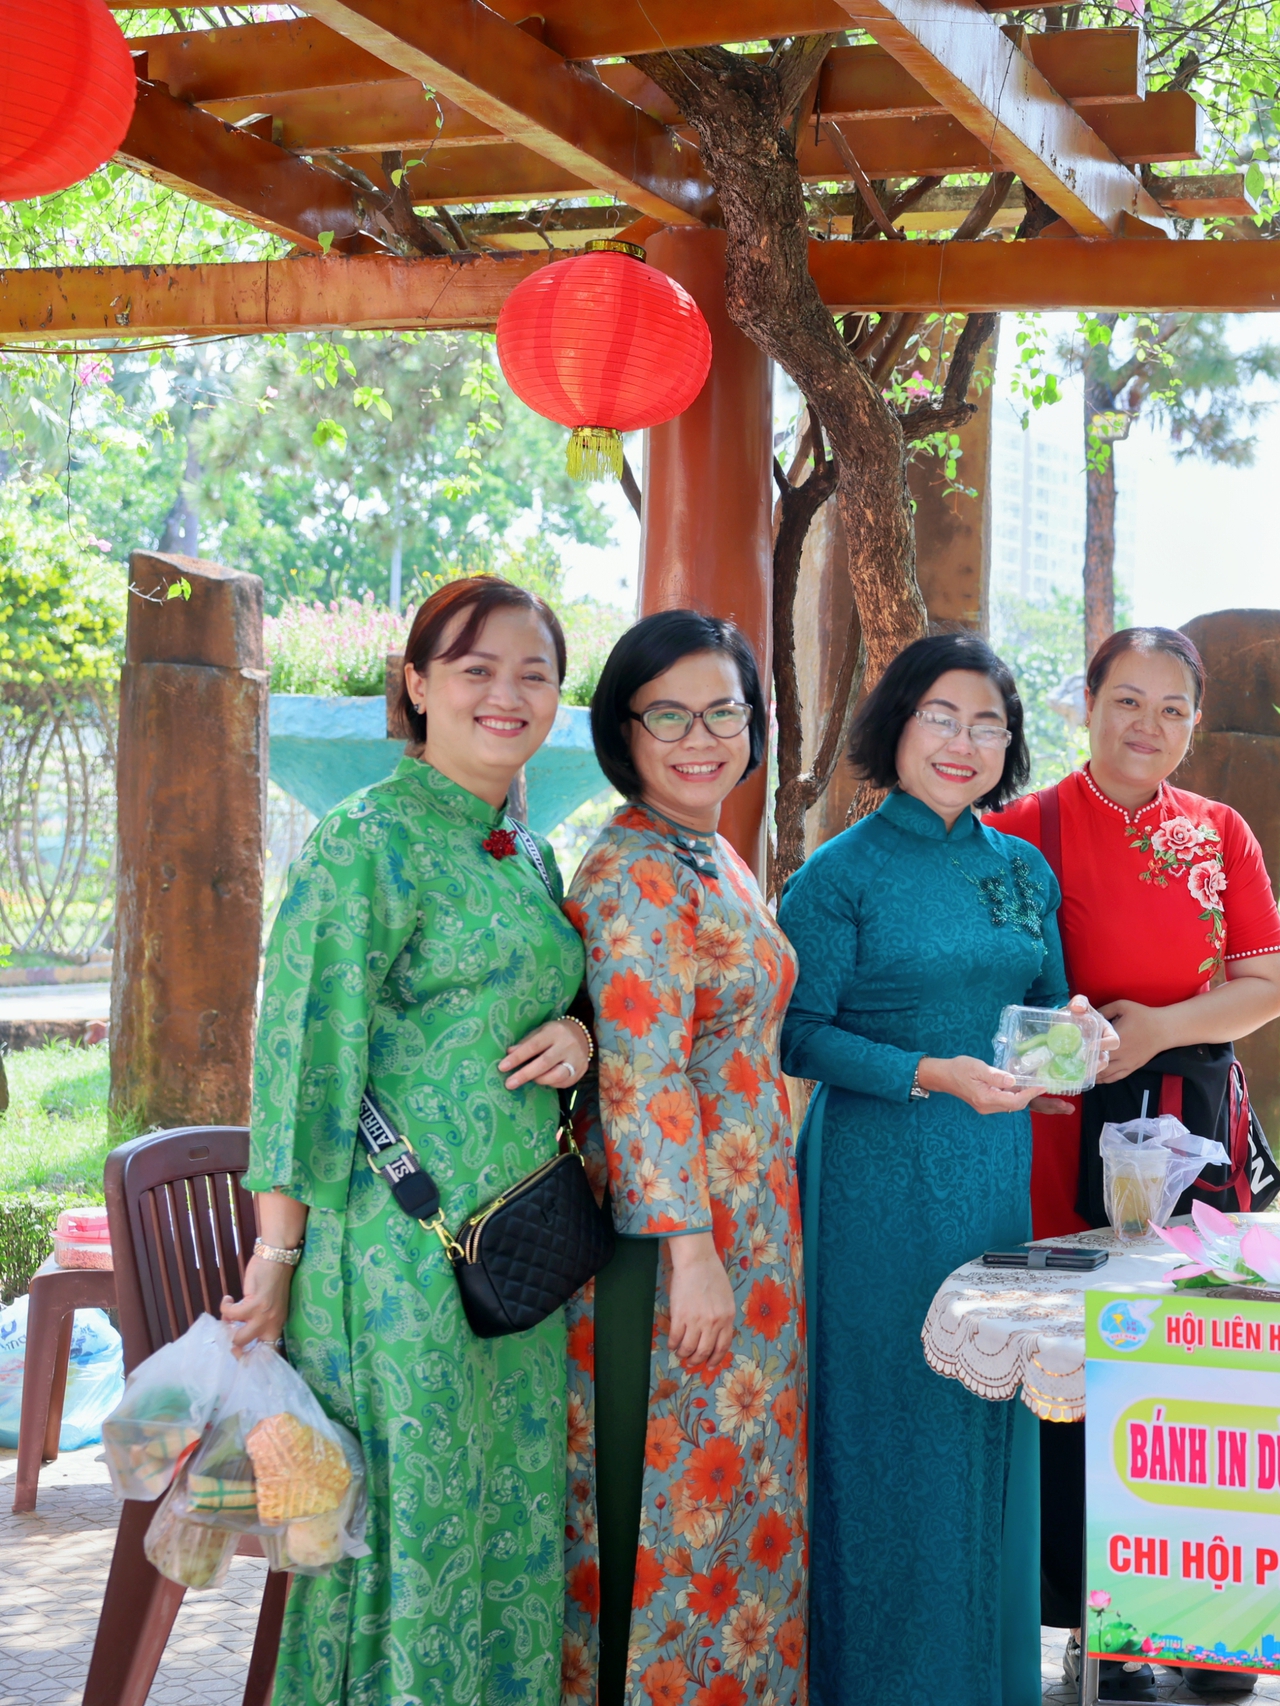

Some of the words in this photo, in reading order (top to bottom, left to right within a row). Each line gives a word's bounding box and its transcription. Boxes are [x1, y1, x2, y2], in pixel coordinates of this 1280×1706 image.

[1166, 1312, 1203, 1352] HỘI
[1211, 1315, 1262, 1350] LIÊN
[1130, 1408, 1207, 1484] BÁNH
[1217, 1430, 1247, 1488] IN
[1109, 1534, 1168, 1576] CHI
[1182, 1535, 1242, 1590] HỘI
